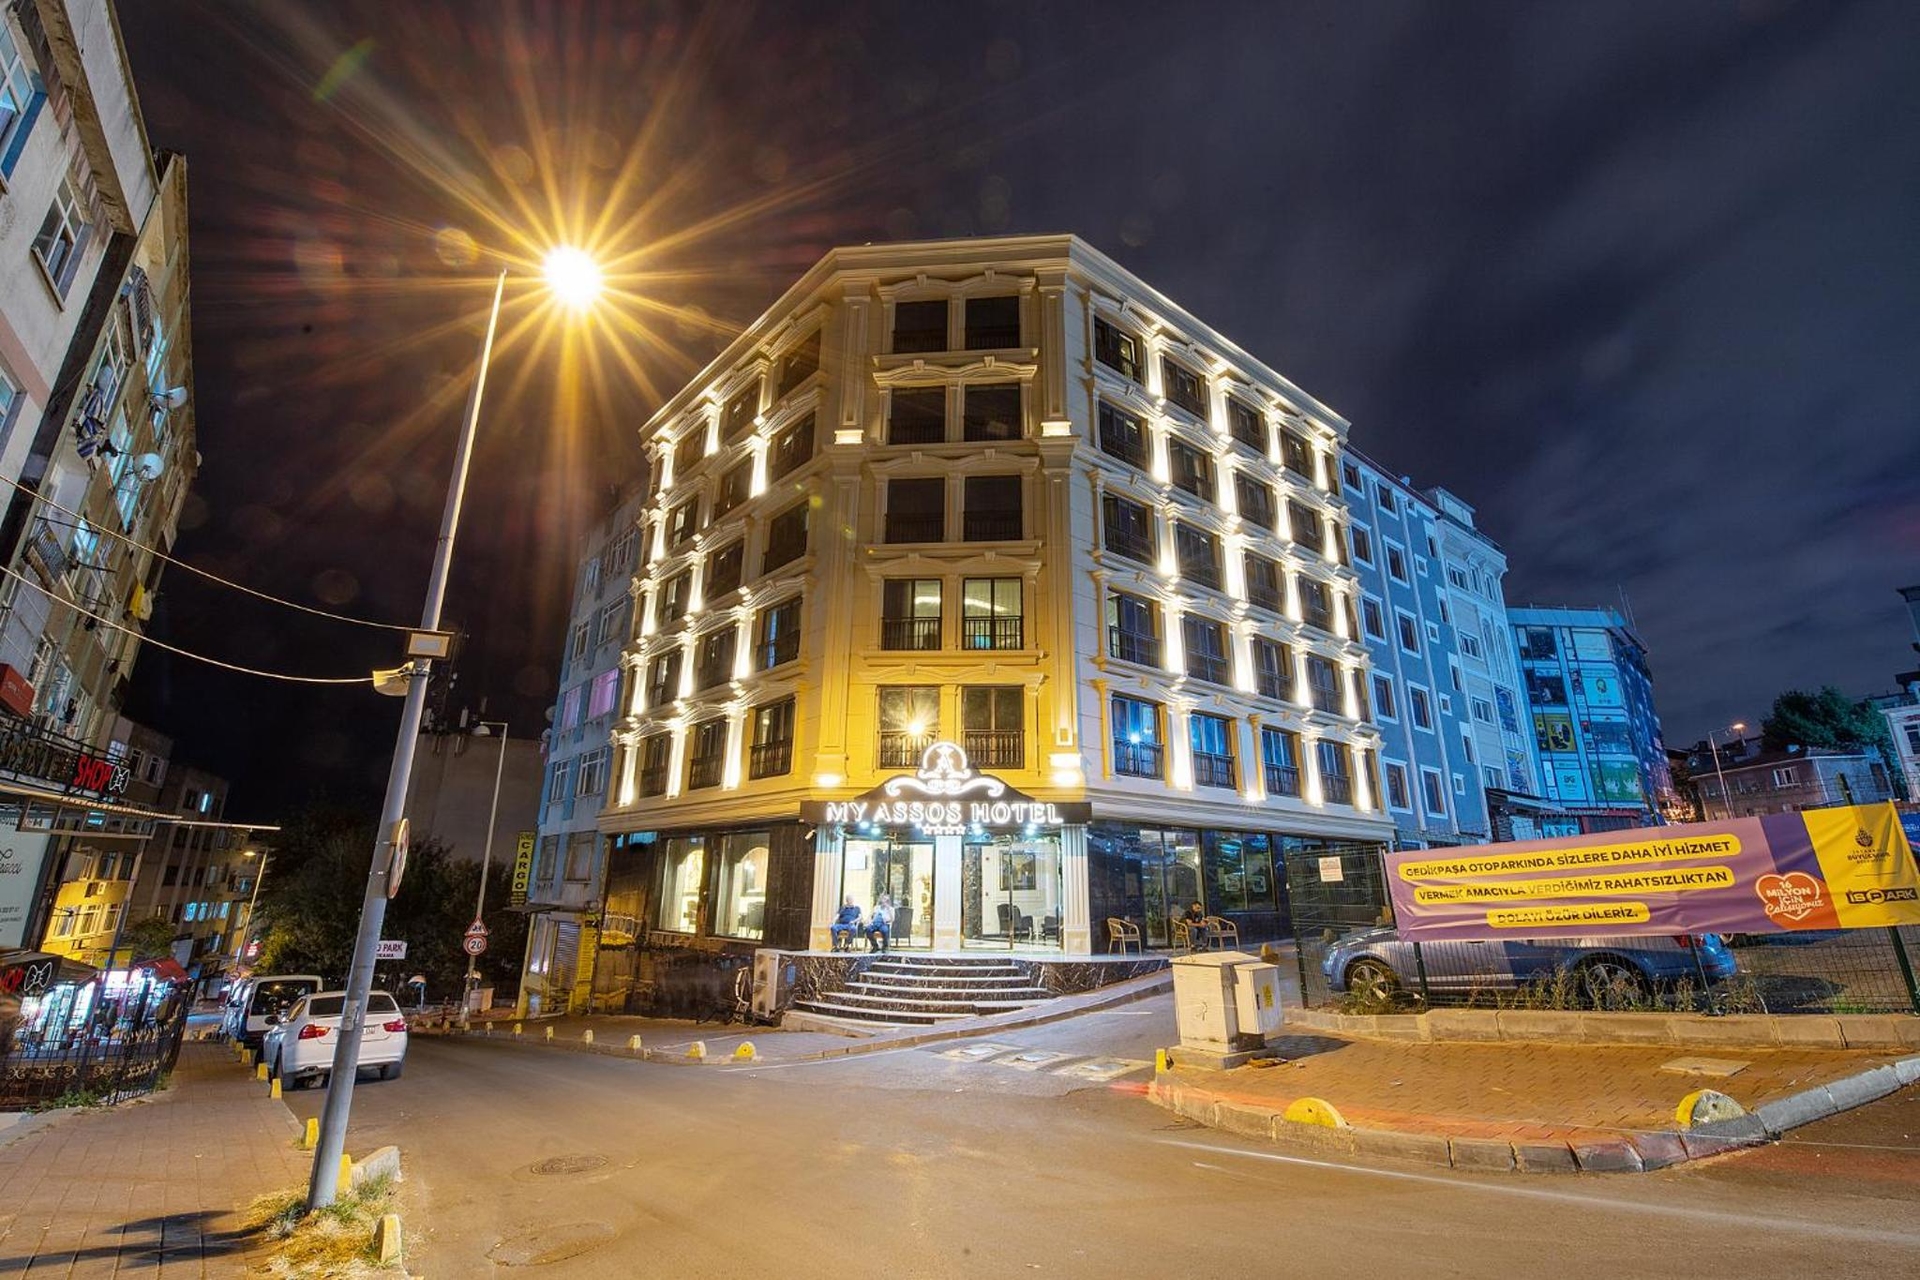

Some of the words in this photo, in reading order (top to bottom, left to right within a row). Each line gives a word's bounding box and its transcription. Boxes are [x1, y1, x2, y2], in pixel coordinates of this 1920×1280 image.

[73, 754, 112, 791] SHOP
[826, 802, 868, 823] MY
[873, 801, 962, 824] ASSOS
[971, 802, 1063, 824] HOTEL
[515, 842, 531, 889] CARGO
[1406, 864, 1467, 877] GEDİKPAŞA
[1469, 857, 1554, 872] OTOPARKINDA
[1557, 852, 1609, 866] SİZLERE
[1612, 848, 1651, 861] DAHA
[1654, 844, 1672, 857] İYİ
[1675, 841, 1730, 854] HİZMET
[1419, 887, 1464, 900] VERMEK
[1466, 886, 1526, 898] AMACIYLA
[1530, 879, 1602, 894] VERDİĞİMİZ
[1605, 871, 1728, 890] RAHATSIZLIKTAN
[1766, 887, 1811, 897] MİLYON
[1779, 881, 1792, 889] 16
[1497, 911, 1543, 923] DOLAYI
[1546, 908, 1580, 921] ÖZÜR
[383, 943, 403, 952] PARK
[471, 941, 482, 949] 20
